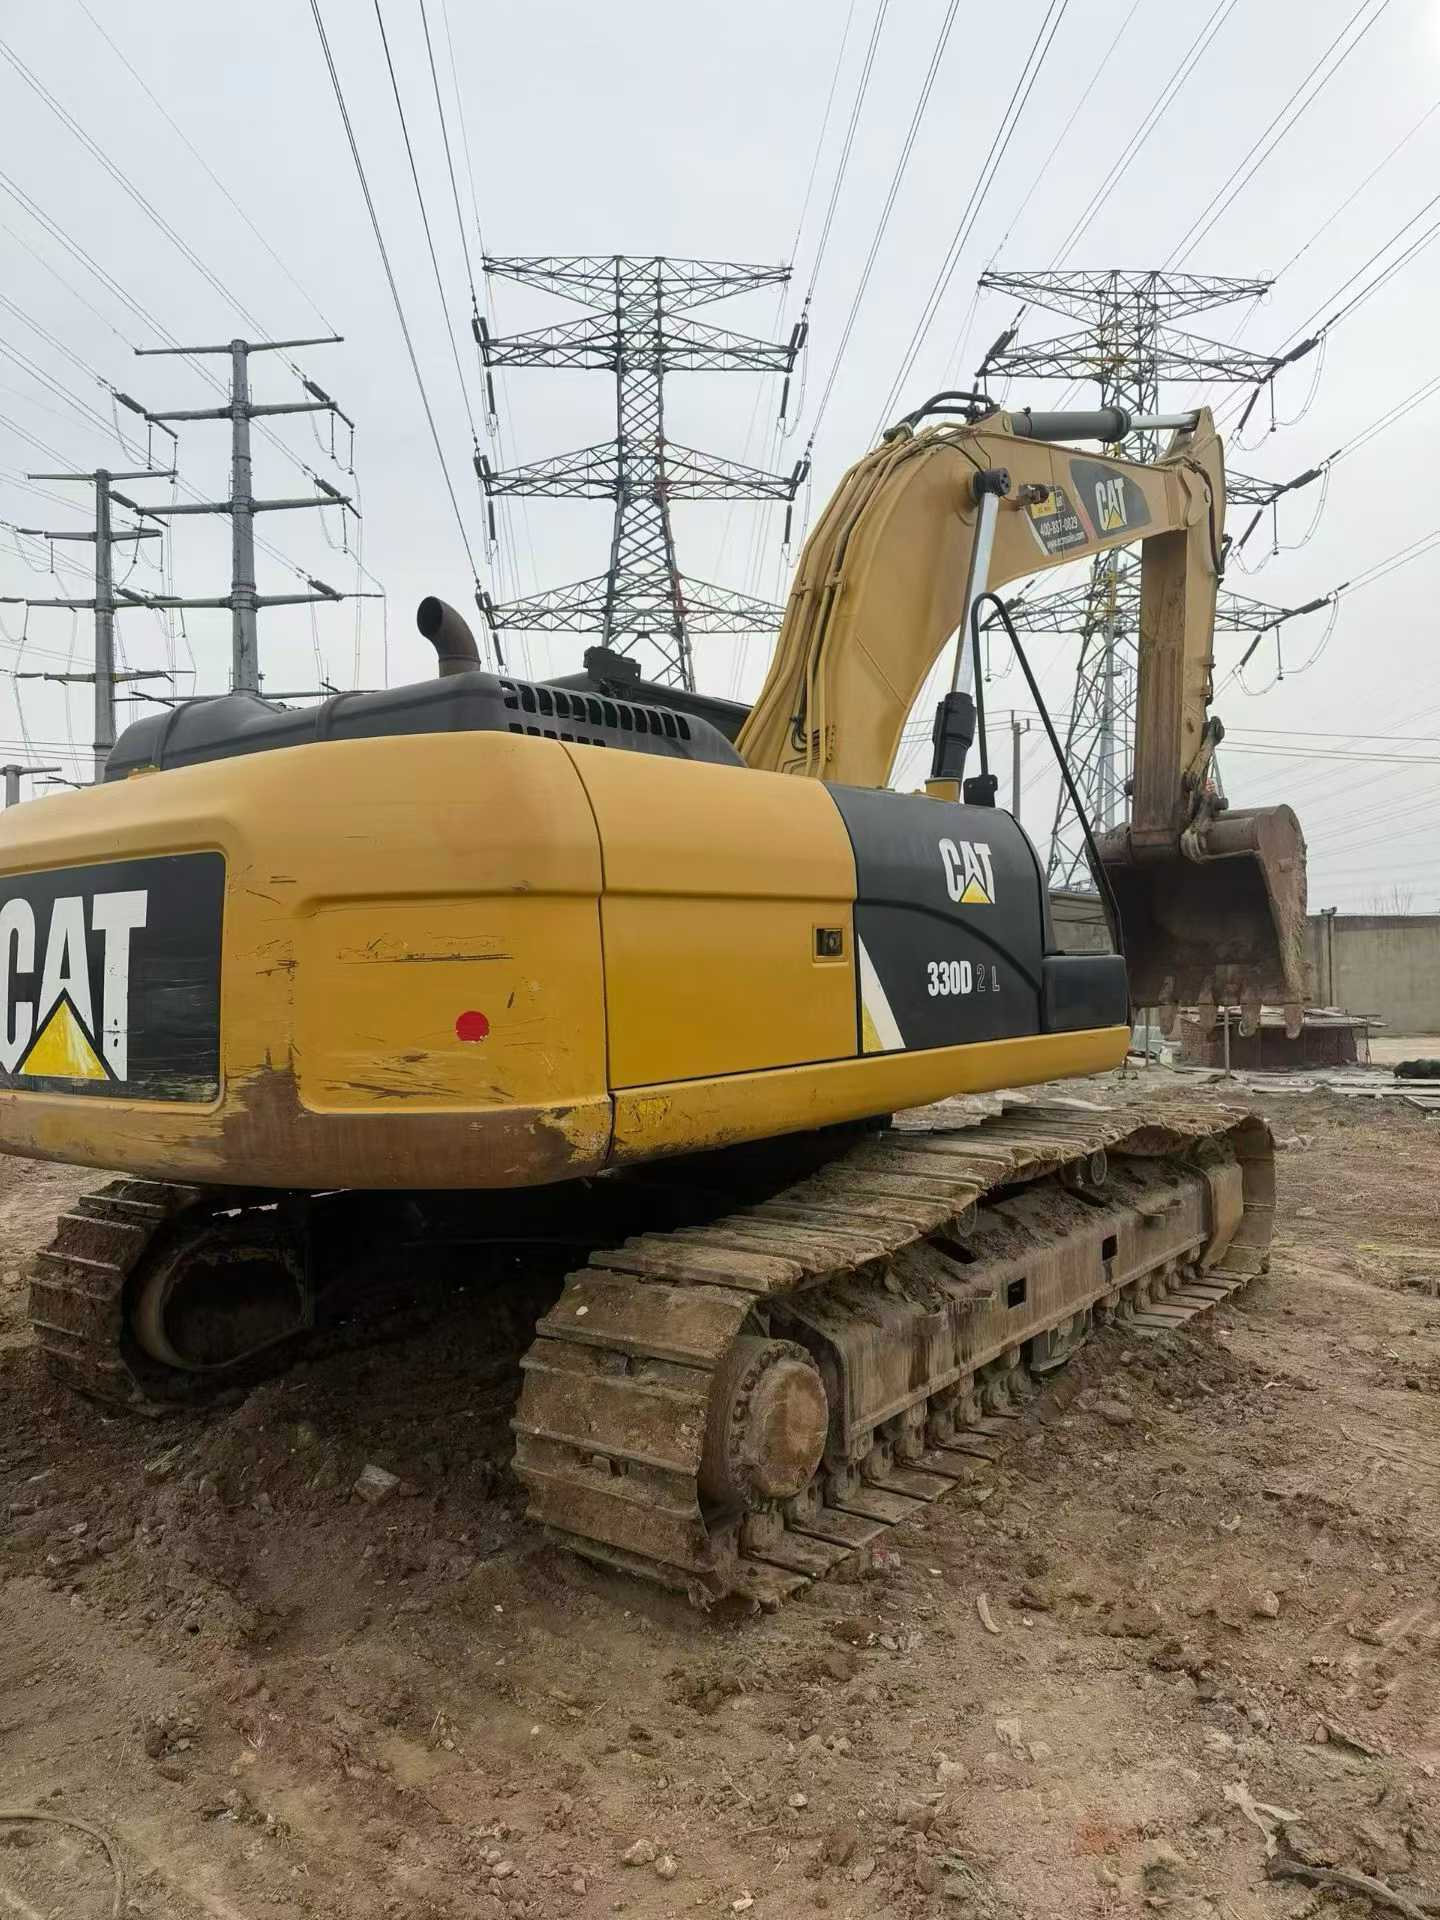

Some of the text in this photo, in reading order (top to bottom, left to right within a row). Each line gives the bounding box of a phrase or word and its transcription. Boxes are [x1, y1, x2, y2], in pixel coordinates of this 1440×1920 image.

[1095, 477, 1128, 531] CAT
[938, 838, 996, 904] CAT
[0, 889, 148, 1082] CAT
[927, 960, 1000, 996] 330D 2 L
